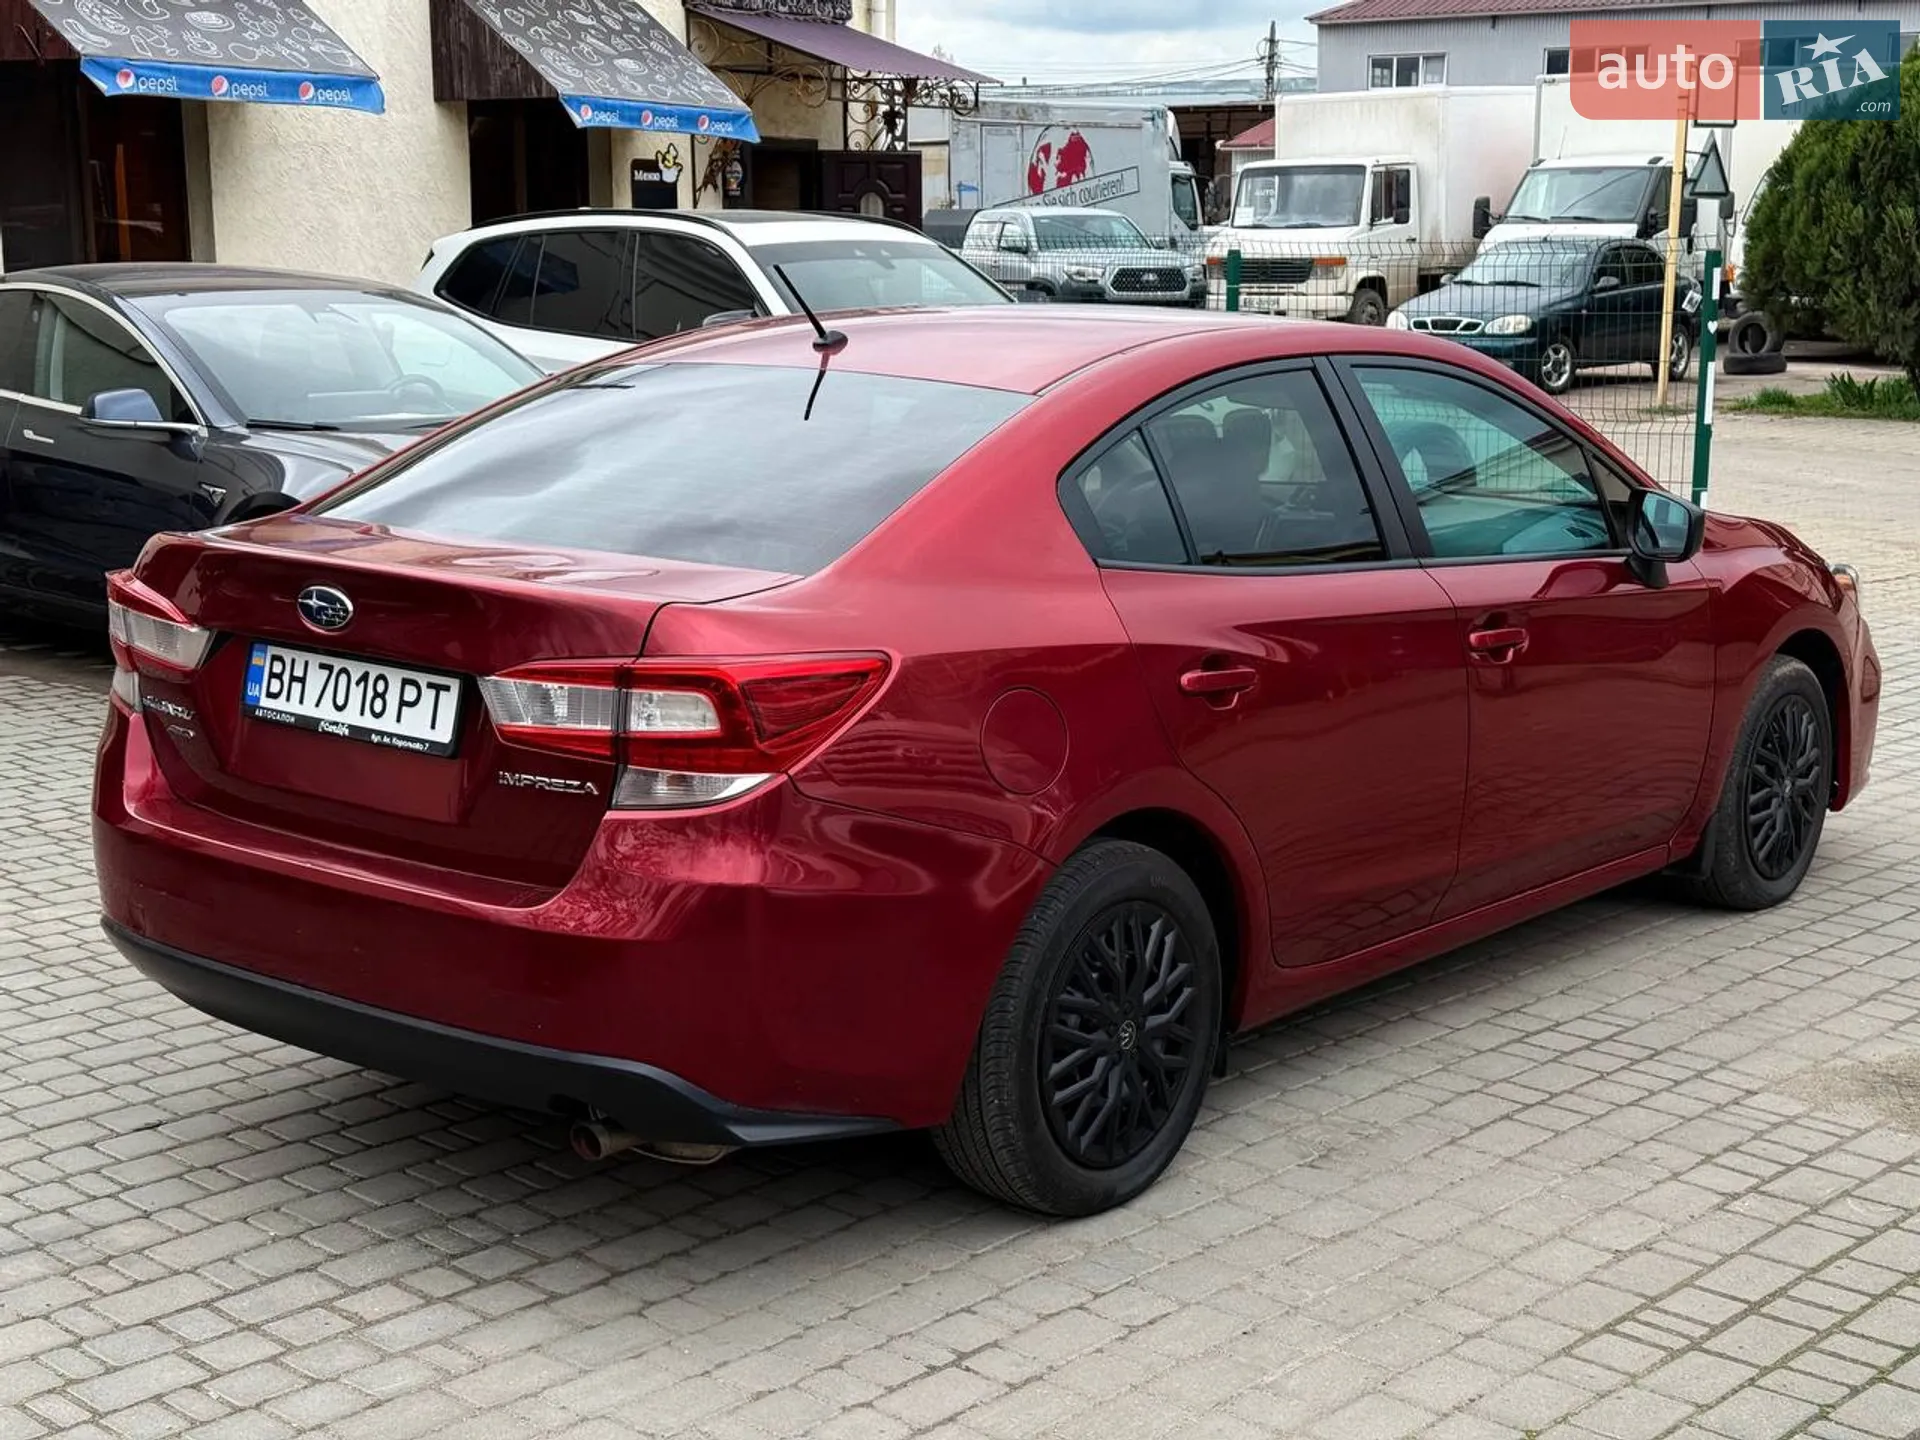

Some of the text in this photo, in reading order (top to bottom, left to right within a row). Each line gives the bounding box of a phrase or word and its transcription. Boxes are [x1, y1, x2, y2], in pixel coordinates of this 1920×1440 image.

[137, 75, 178, 93] pepsi
[231, 81, 268, 98] pepsi
[314, 86, 352, 104] pepsi
[593, 110, 619, 123] pepsi
[653, 114, 679, 129] pepsi
[709, 121, 733, 134] pepsi
[247, 682, 260, 697] UA
[265, 653, 451, 730] BH 7018 PT
[254, 709, 296, 724] АВТОСАЛОН
[498, 770, 600, 796] IMPREZA
